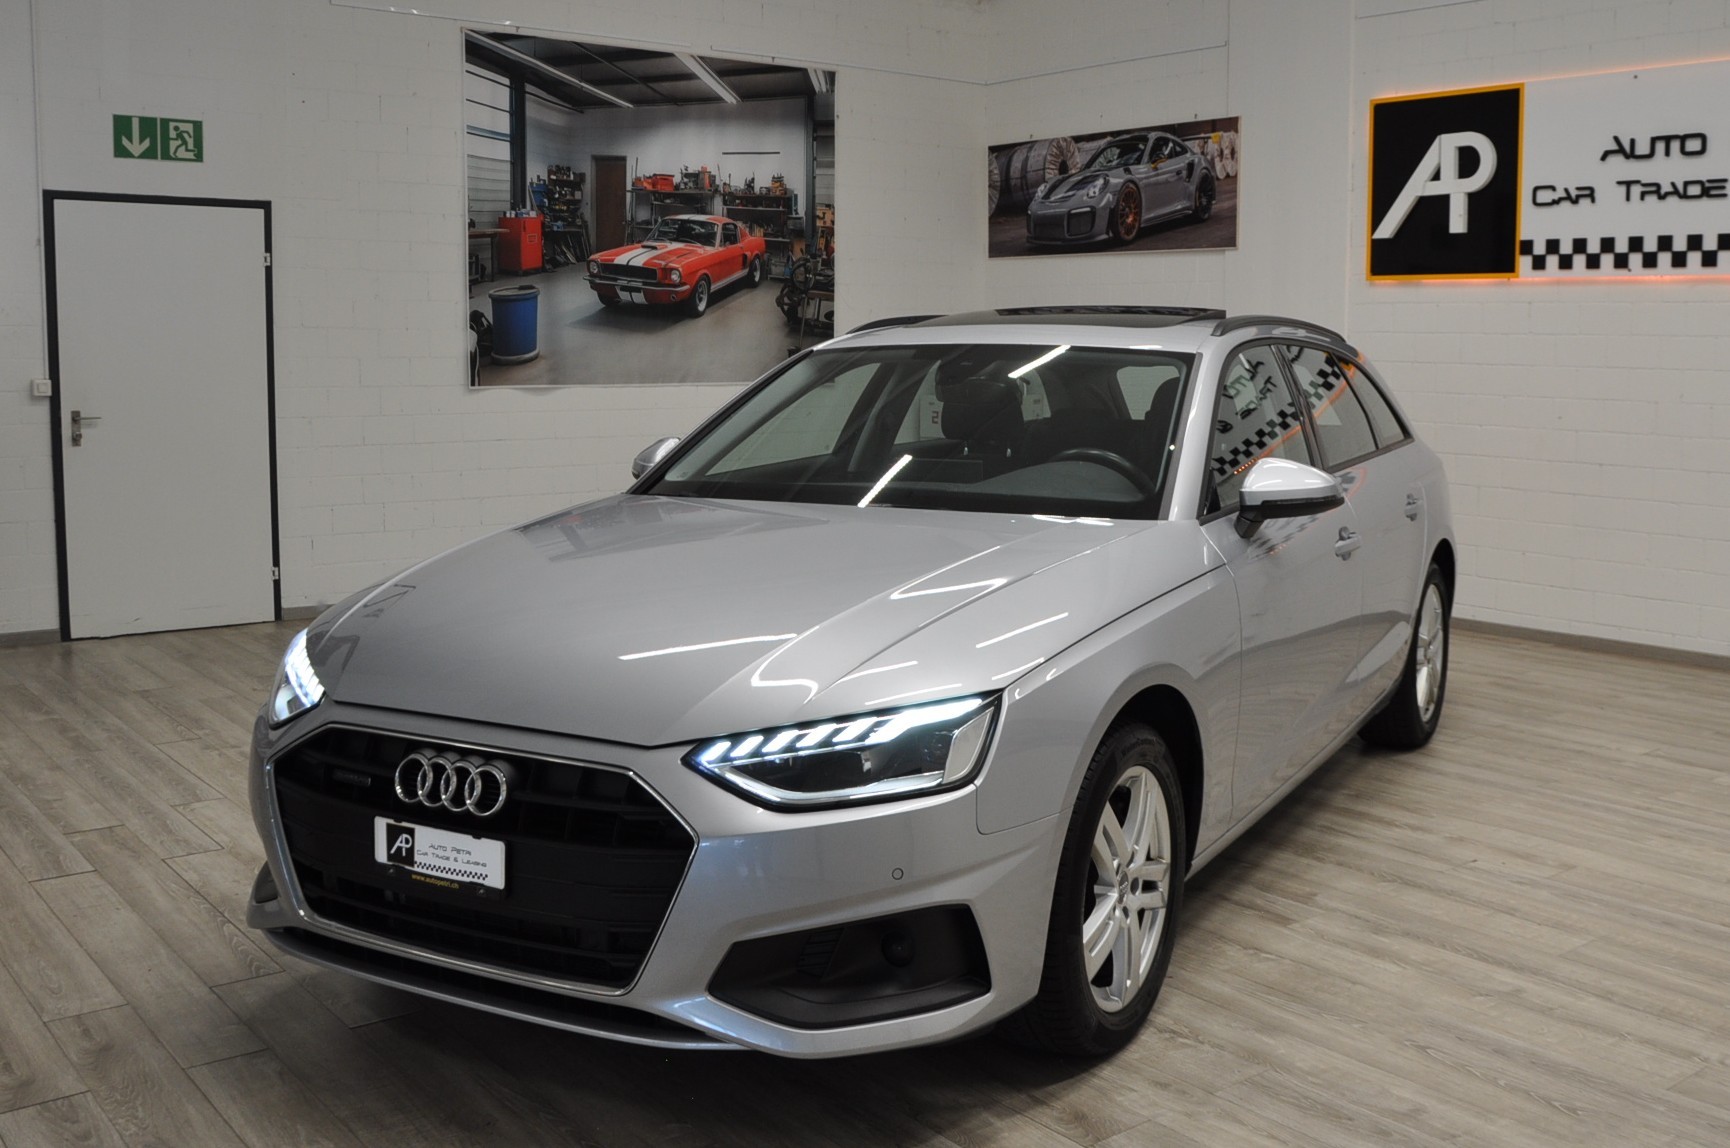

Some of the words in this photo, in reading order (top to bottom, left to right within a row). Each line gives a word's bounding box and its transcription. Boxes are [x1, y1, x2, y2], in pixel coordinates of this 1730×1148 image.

[1600, 132, 1707, 162] AUTO
[1372, 131, 1498, 240] AP
[1532, 184, 1596, 207] CAR
[1616, 178, 1729, 202] TRADE
[428, 842, 448, 852] AUTO
